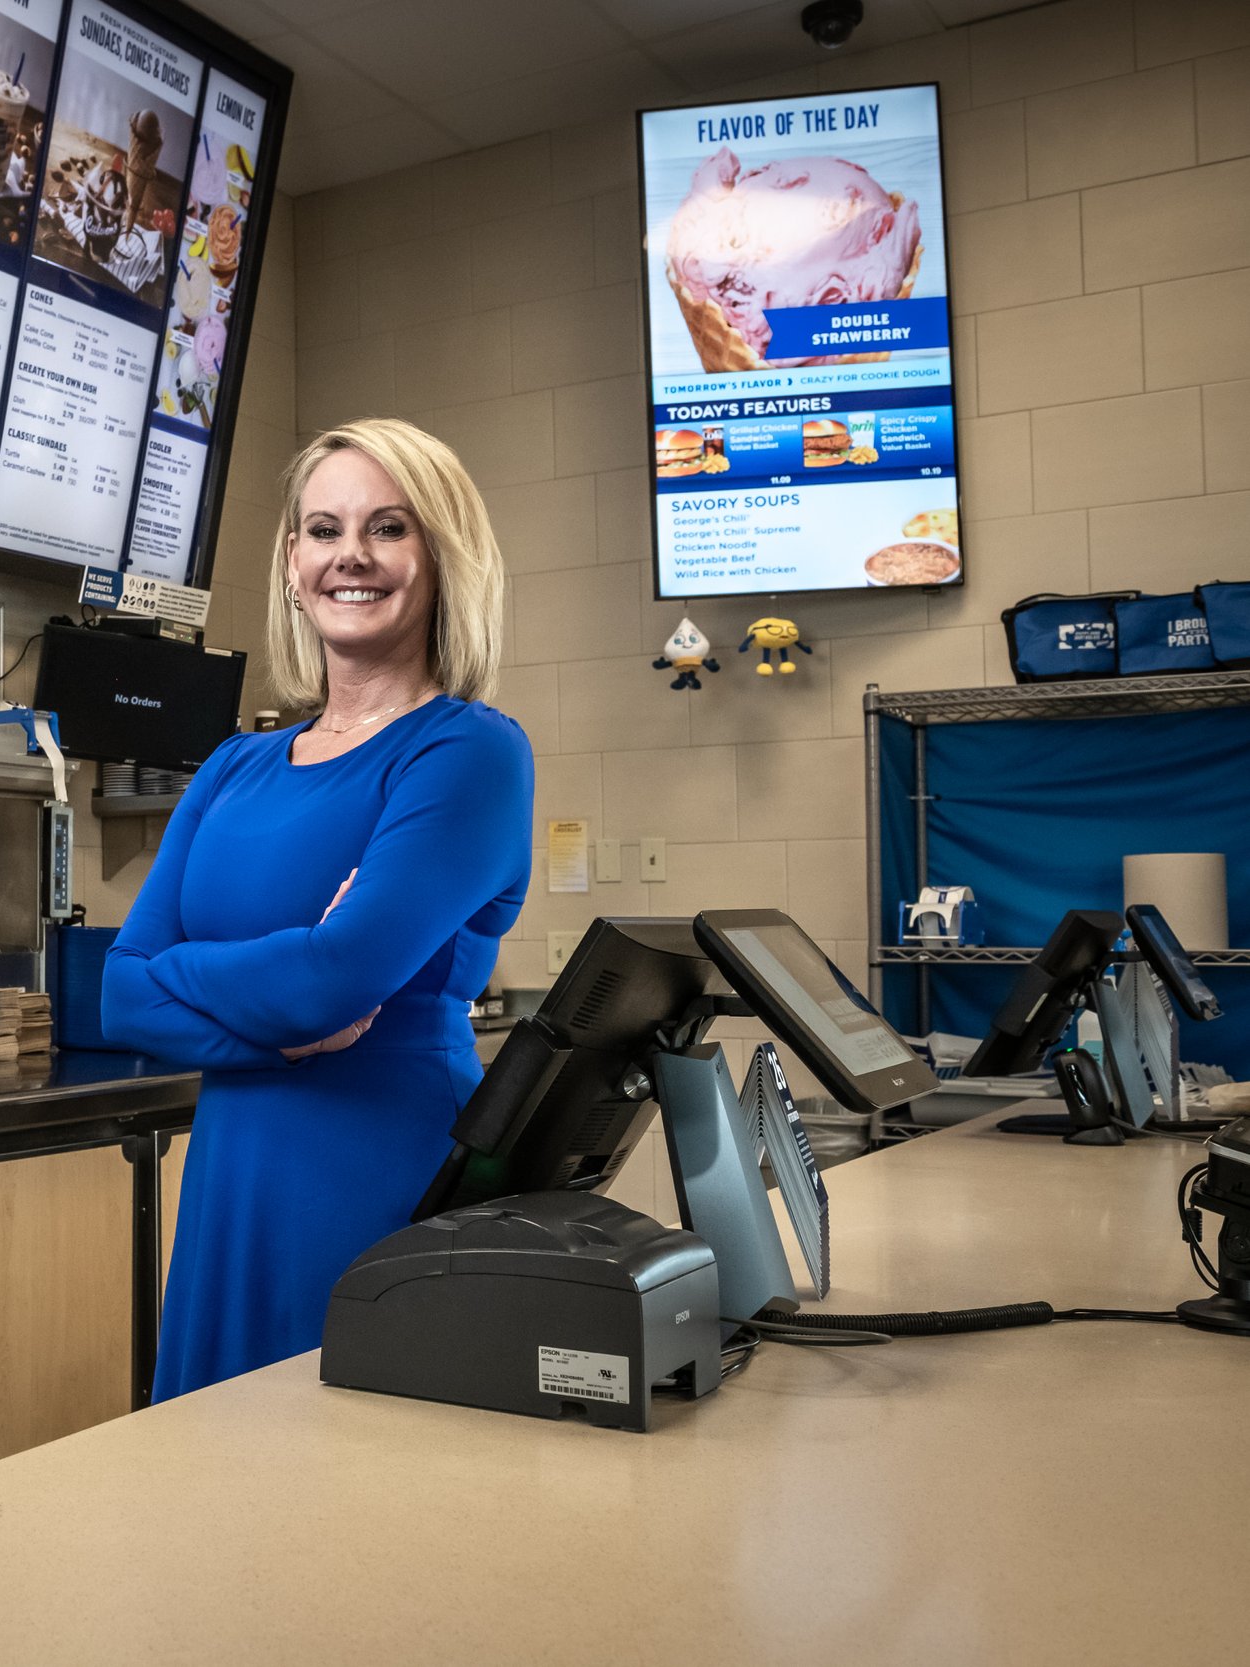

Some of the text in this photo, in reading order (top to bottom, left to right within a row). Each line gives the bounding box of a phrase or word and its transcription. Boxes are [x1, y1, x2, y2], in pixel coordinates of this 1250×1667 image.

[100, 11, 178, 63] FRESH FROZEN CUSTARD
[80, 15, 190, 96] SUNDAES, CONES & DISHES
[216, 91, 256, 130] LEMON ICE
[698, 104, 879, 143] FLAVOR OF THE DAY
[30, 290, 53, 306] CONES
[831, 313, 889, 329] DOUBLE
[812, 327, 911, 345] STRAWBERRY
[19, 361, 44, 377] CREATE
[46, 370, 64, 384] YOUR
[66, 376, 81, 389] OWN
[82, 381, 97, 394] DISH
[664, 368, 940, 394] TOMORROW'S FLAVOR CRAZY FOR COOKIE DOUGH
[667, 398, 831, 421] TODAY'S FEATURES
[880, 414, 937, 426] Spicy Crispy
[729, 422, 798, 435] Grilled Chicken
[881, 424, 917, 434] Chicken
[8, 427, 67, 452] CLASSIC SUNDAES
[730, 433, 773, 443] Sandwich
[881, 432, 925, 443] Sandwich
[150, 440, 172, 455] COOLER
[730, 441, 779, 451] Value Basket
[882, 441, 931, 451] Value Basket
[143, 477, 172, 493] SMOOTHIE
[671, 494, 800, 512] SAVORY SOUPS
[673, 516, 719, 525] George's
[674, 530, 719, 539] George's
[754, 526, 801, 535] Supreme
[674, 541, 757, 552] Chicken Noodle
[675, 554, 755, 566] Vegetable Beef
[675, 570, 699, 578] Wild
[703, 569, 725, 577] Rice
[755, 566, 796, 575] Chicken
[97, 575, 112, 584] SERVE
[86, 582, 112, 593] PRODUCTS
[1175, 618, 1207, 631] BROU
[1168, 634, 1209, 647] PARTY
[115, 694, 162, 709] No Orders
[768, 1051, 786, 1090] 26
[541, 1348, 560, 1357] EPSON
